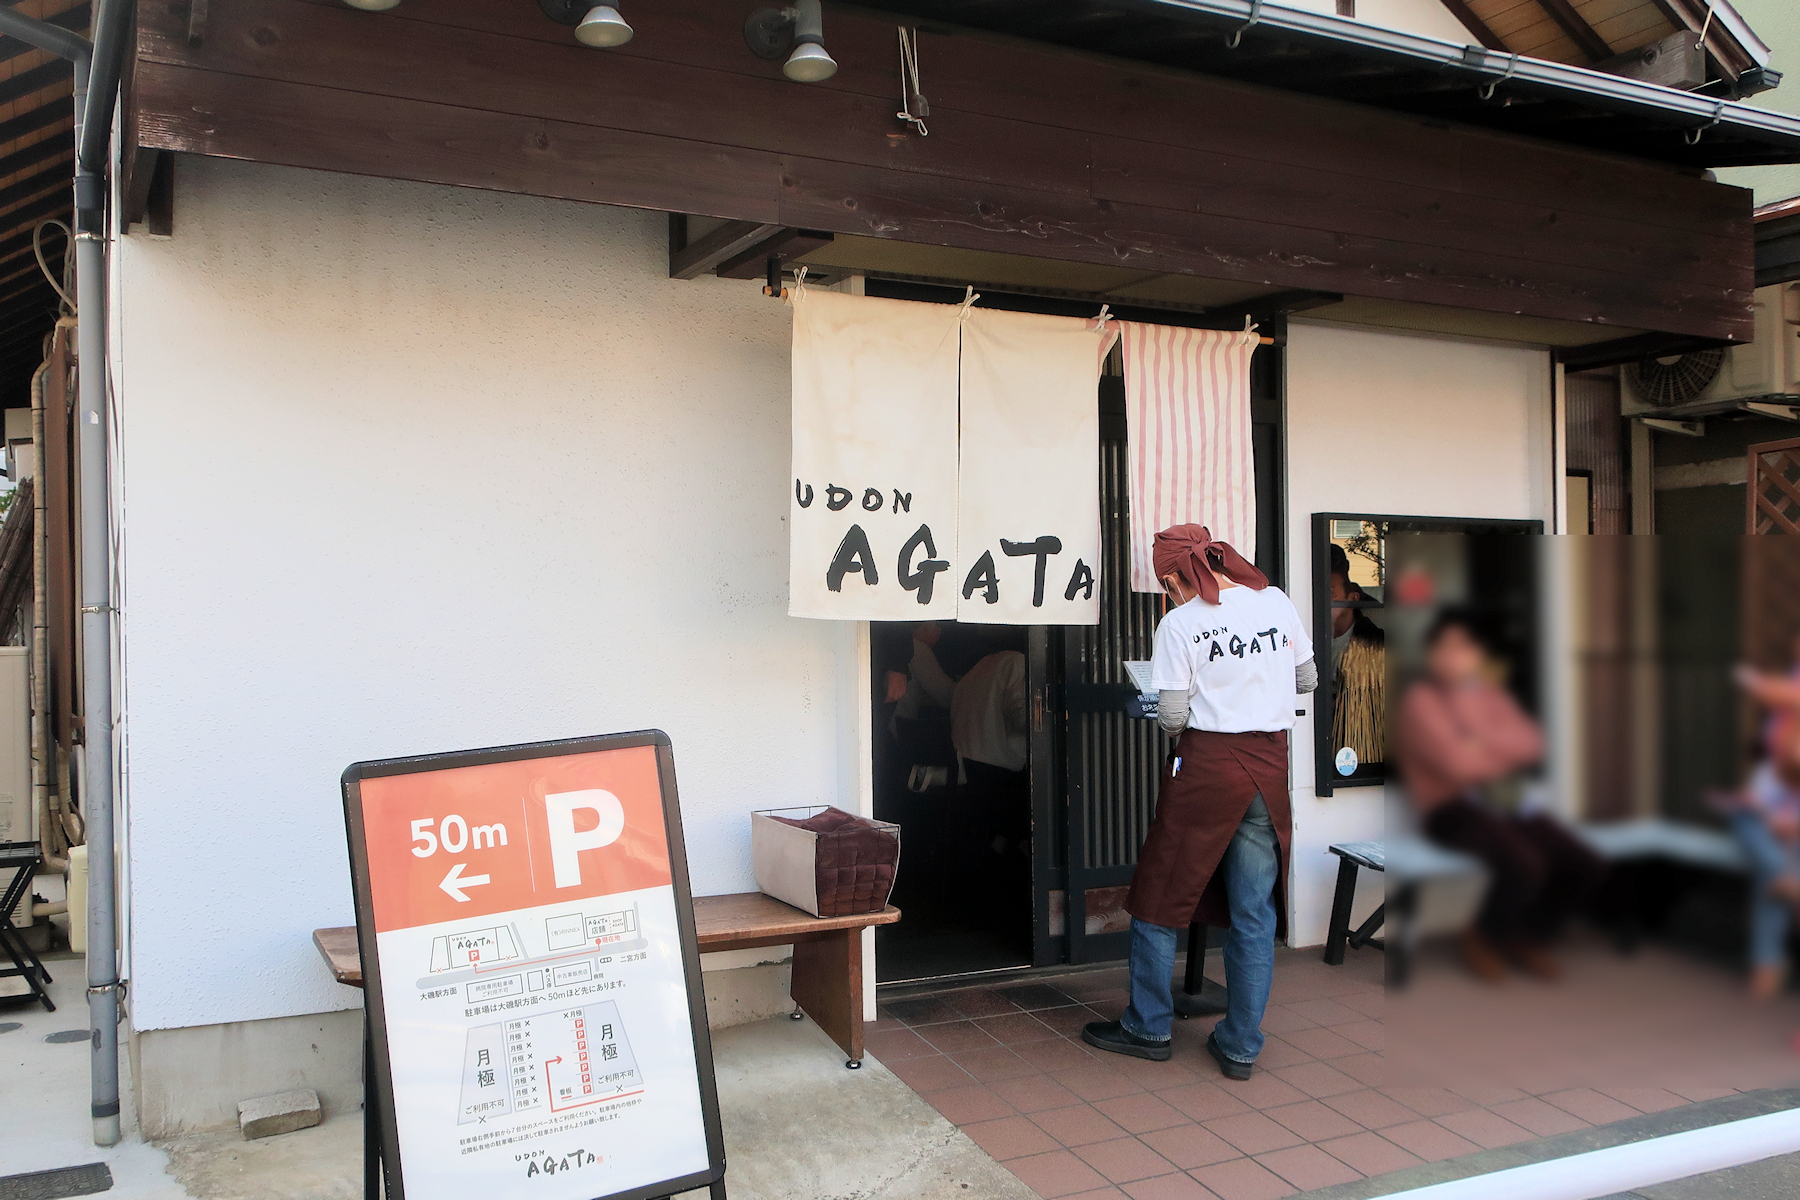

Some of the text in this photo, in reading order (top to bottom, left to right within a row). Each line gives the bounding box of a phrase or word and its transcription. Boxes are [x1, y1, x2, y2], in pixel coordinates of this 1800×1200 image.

[796, 478, 912, 514] UDON
[826, 523, 1095, 607] AGATA
[1193, 626, 1228, 644] UDON
[1209, 627, 1289, 662] AGATA
[410, 814, 508, 859] 50m
[545, 788, 625, 889] P
[458, 937, 491, 950] AGATA
[602, 934, 621, 944] 現在地
[620, 951, 647, 963] 二宮方面
[420, 986, 458, 1001] 大磯駅方面
[601, 1023, 618, 1061] 月極
[477, 1048, 496, 1088] 月極
[598, 1069, 634, 1084] ご利用不可
[465, 1098, 505, 1115] ご利用不可
[515, 1149, 545, 1162] UDON
[527, 1149, 596, 1178] AGATA
